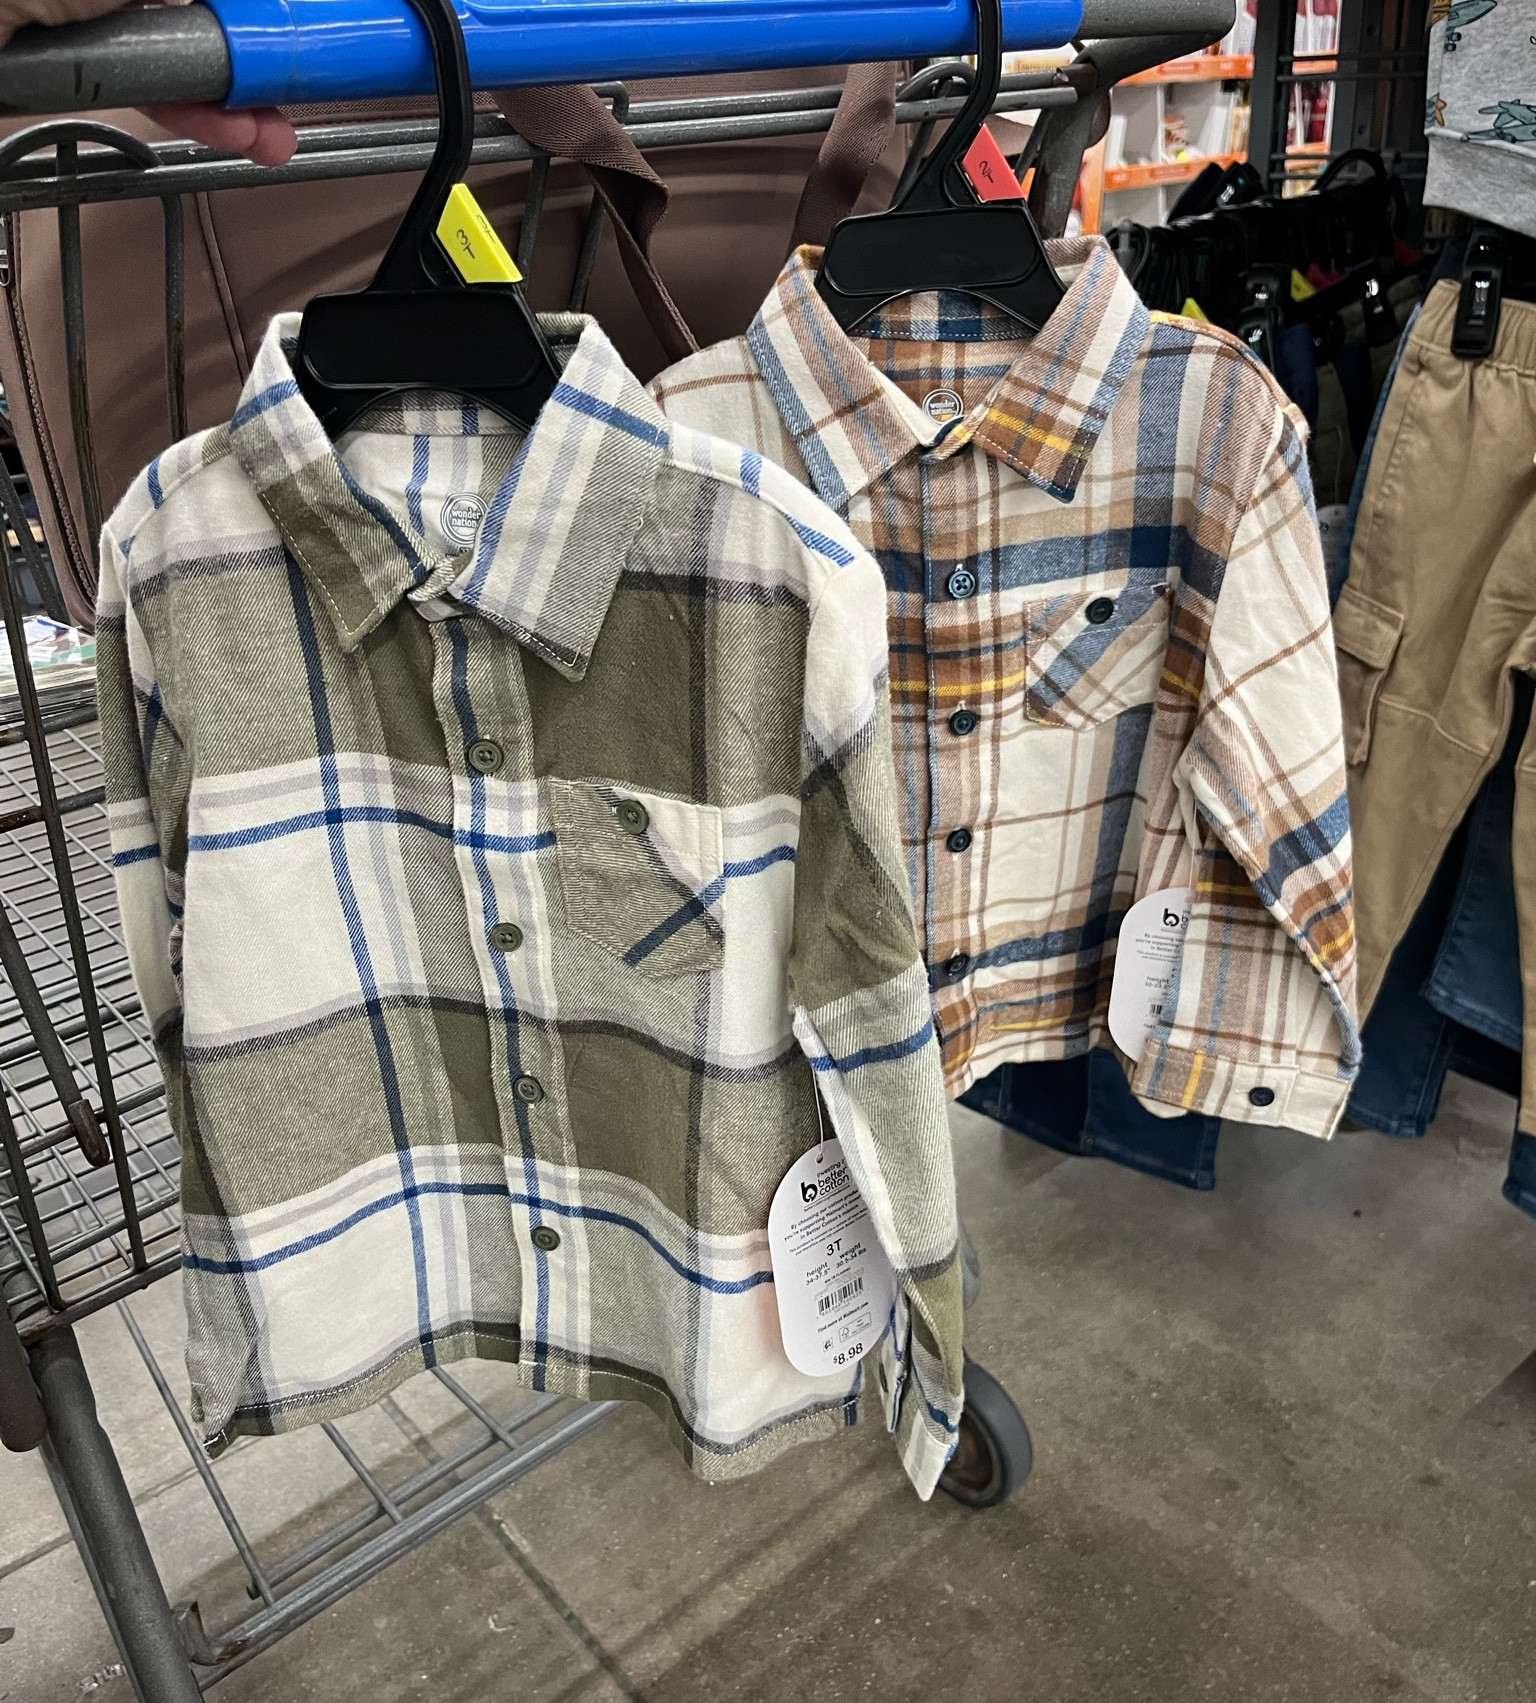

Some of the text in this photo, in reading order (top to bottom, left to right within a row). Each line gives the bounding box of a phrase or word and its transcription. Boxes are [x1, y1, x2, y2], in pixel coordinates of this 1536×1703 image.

[980, 161, 994, 184] 2T
[456, 229, 475, 259] 3T
[930, 400, 955, 409] wonder
[451, 507, 481, 520] wonder
[451, 517, 477, 528] nation
[817, 1166, 848, 1187] better
[819, 1175, 850, 1196] cotton
[798, 1212, 818, 1226] choosing
[800, 1215, 825, 1233] supporting
[806, 1225, 820, 1236] Better
[822, 1213, 841, 1227] Cotton's
[826, 1238, 842, 1256] 3T
[839, 1242, 861, 1259] weight
[806, 1262, 827, 1278] height
[833, 1342, 863, 1365] $8.98
